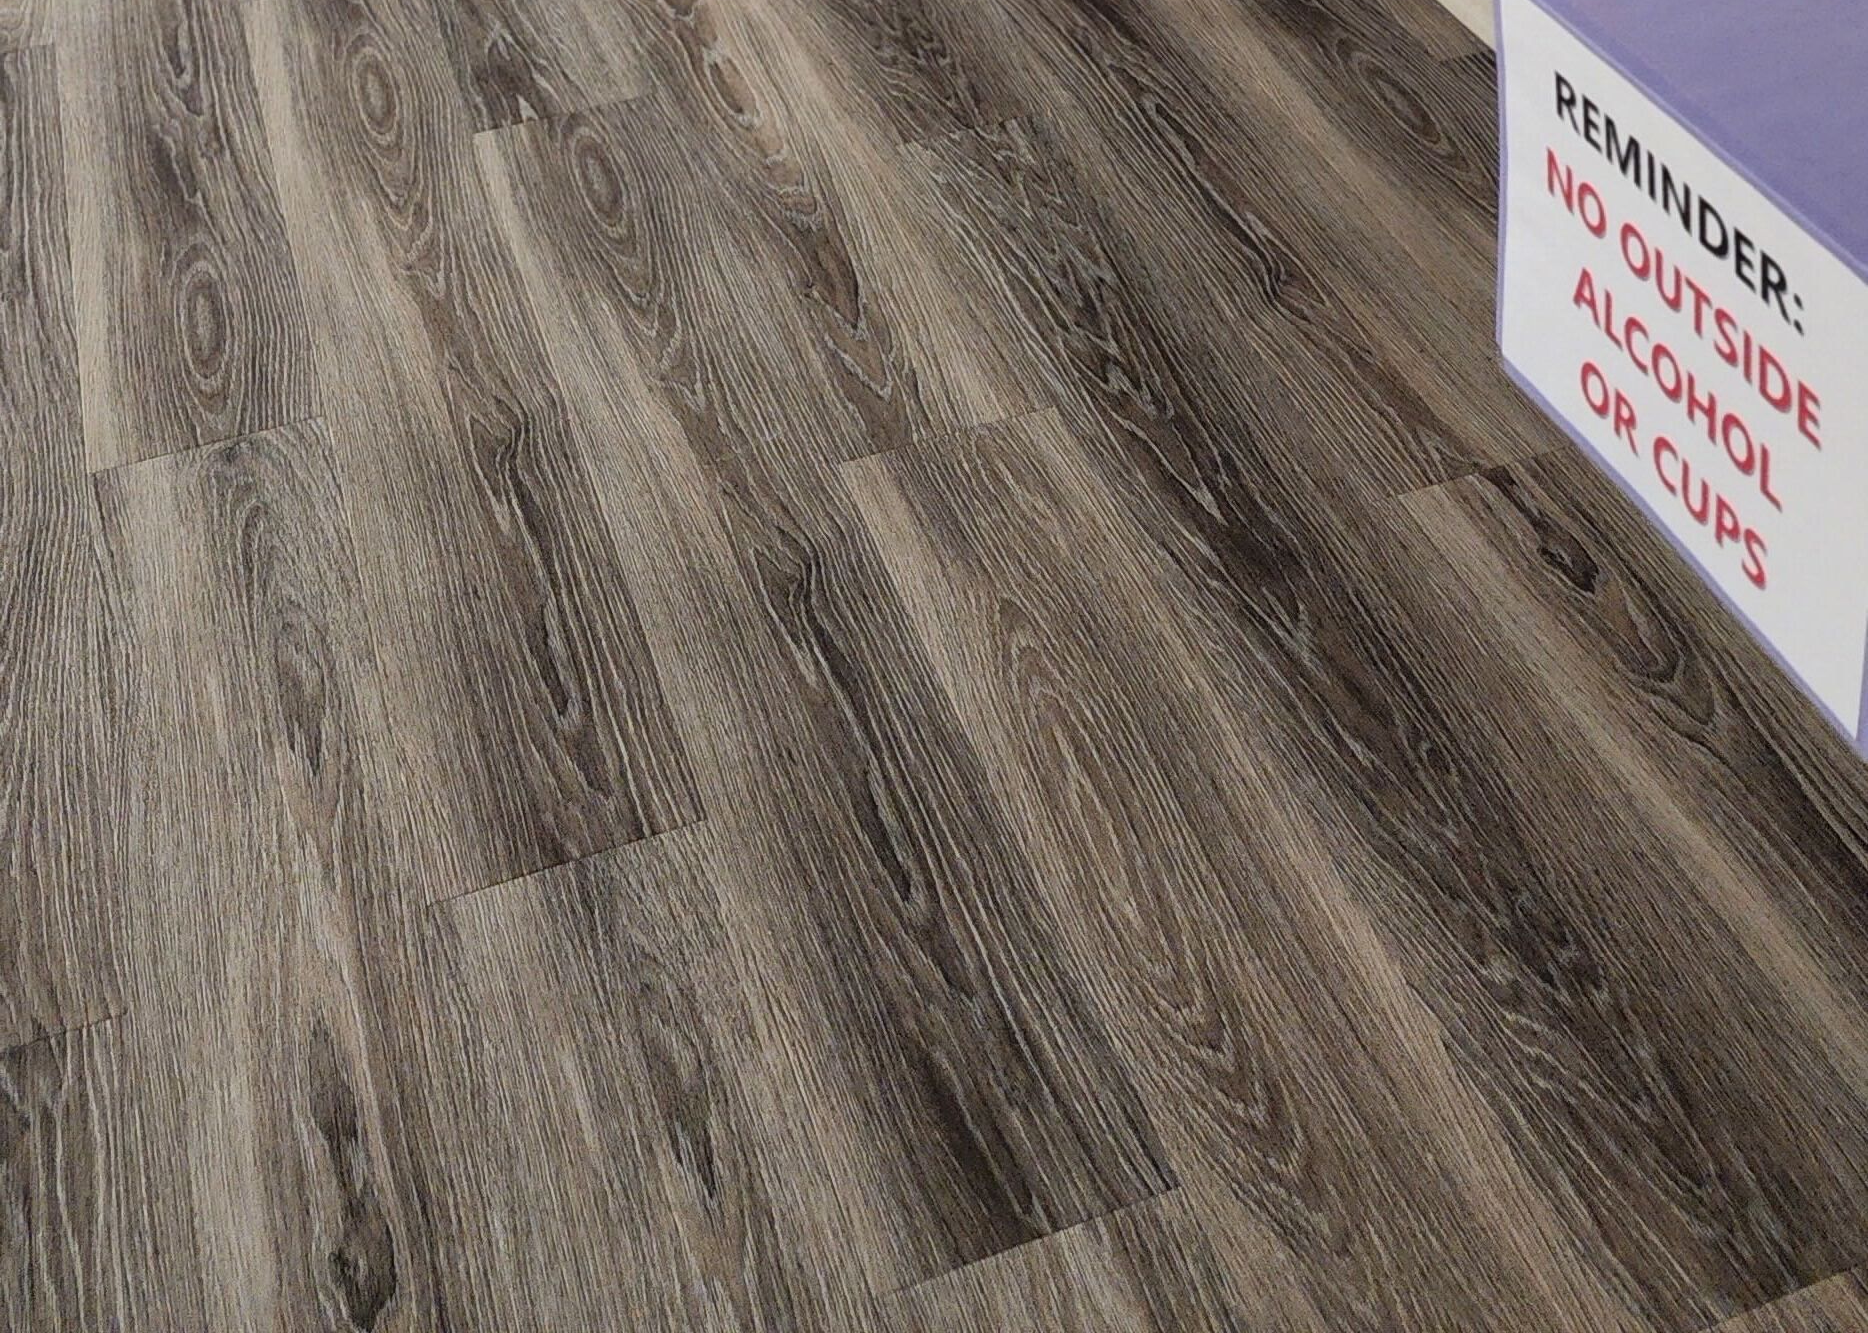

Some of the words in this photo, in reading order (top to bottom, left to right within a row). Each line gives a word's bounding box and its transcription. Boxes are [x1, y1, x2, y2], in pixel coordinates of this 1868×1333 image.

[1546, 147, 1607, 239] NO
[1619, 222, 1821, 449] OUTSIDE
[1554, 70, 1804, 335] REMINDER:
[1573, 268, 1782, 511] ALCOHOL
[1580, 361, 1640, 456] OR
[1652, 435, 1768, 590] CUPS
